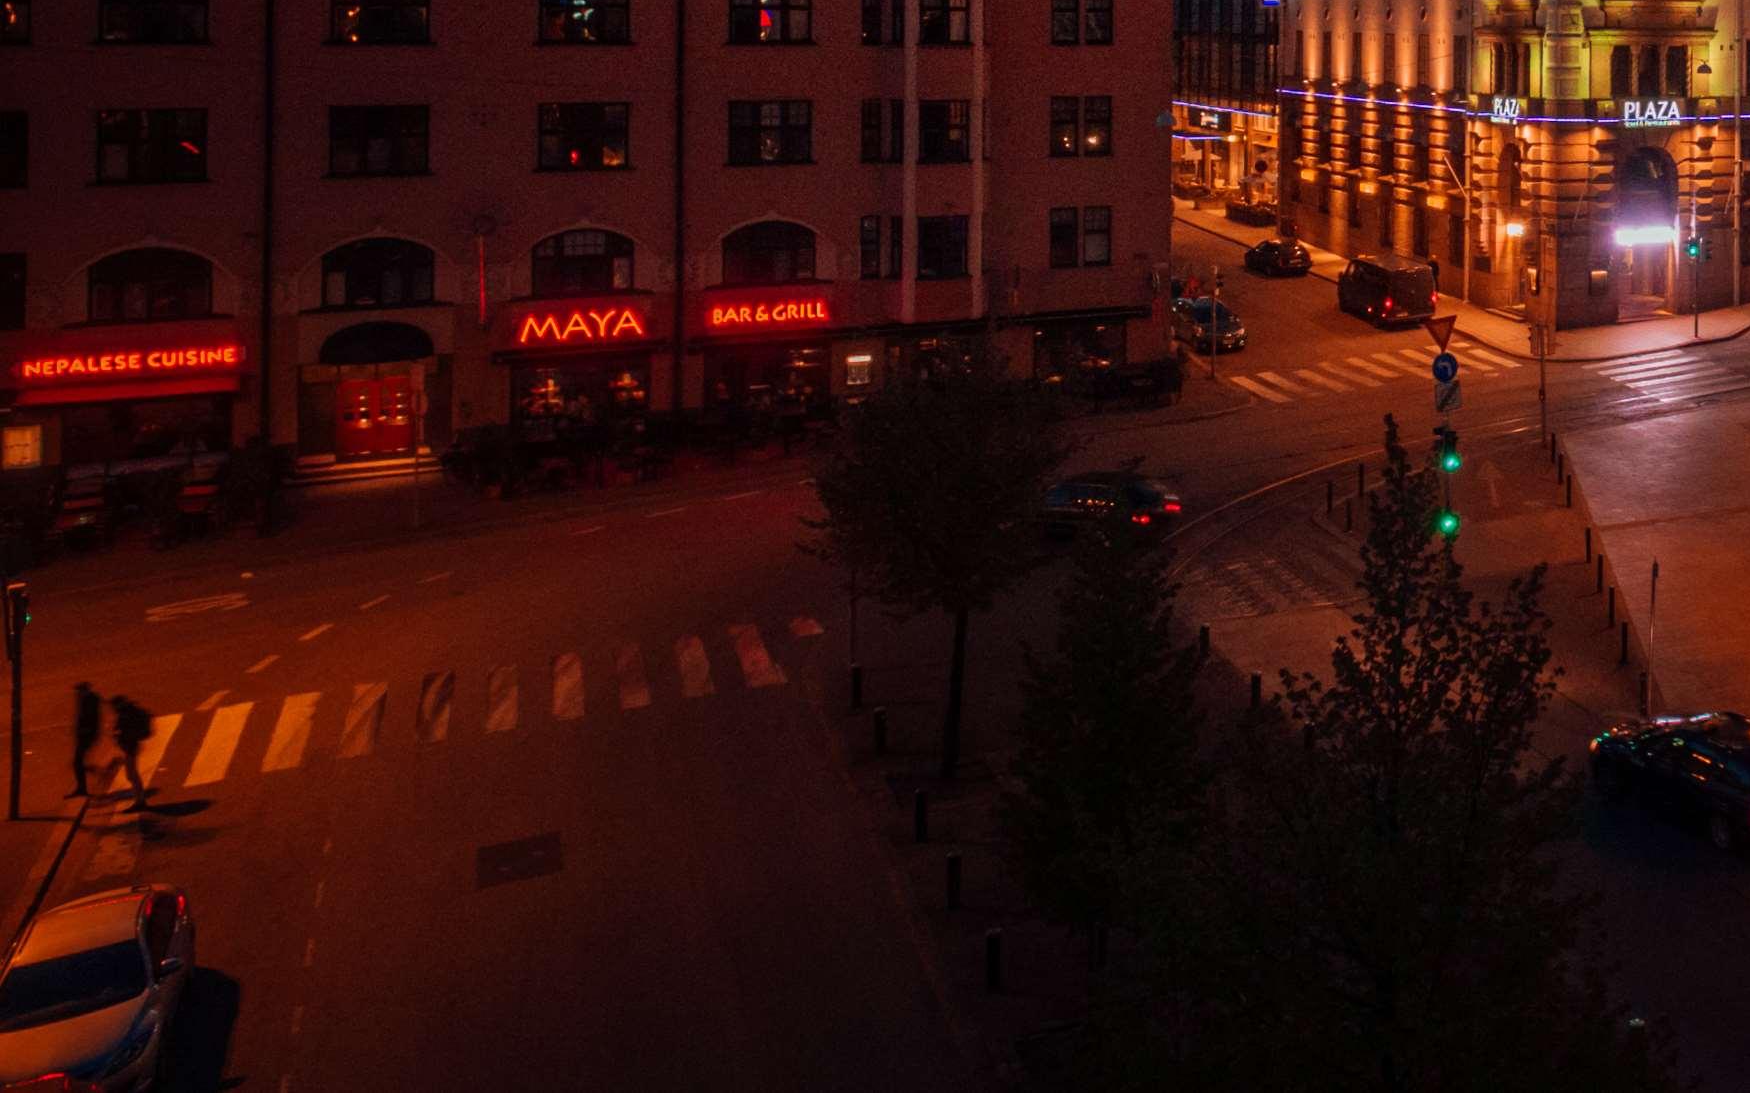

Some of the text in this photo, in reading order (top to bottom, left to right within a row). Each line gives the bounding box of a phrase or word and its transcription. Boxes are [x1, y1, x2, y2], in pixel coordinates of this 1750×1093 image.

[1624, 101, 1681, 120] PLAZA
[519, 309, 644, 343] MAYA
[712, 302, 826, 325] BAR & GRILL
[23, 348, 236, 377] NEPALESE CUISINE
